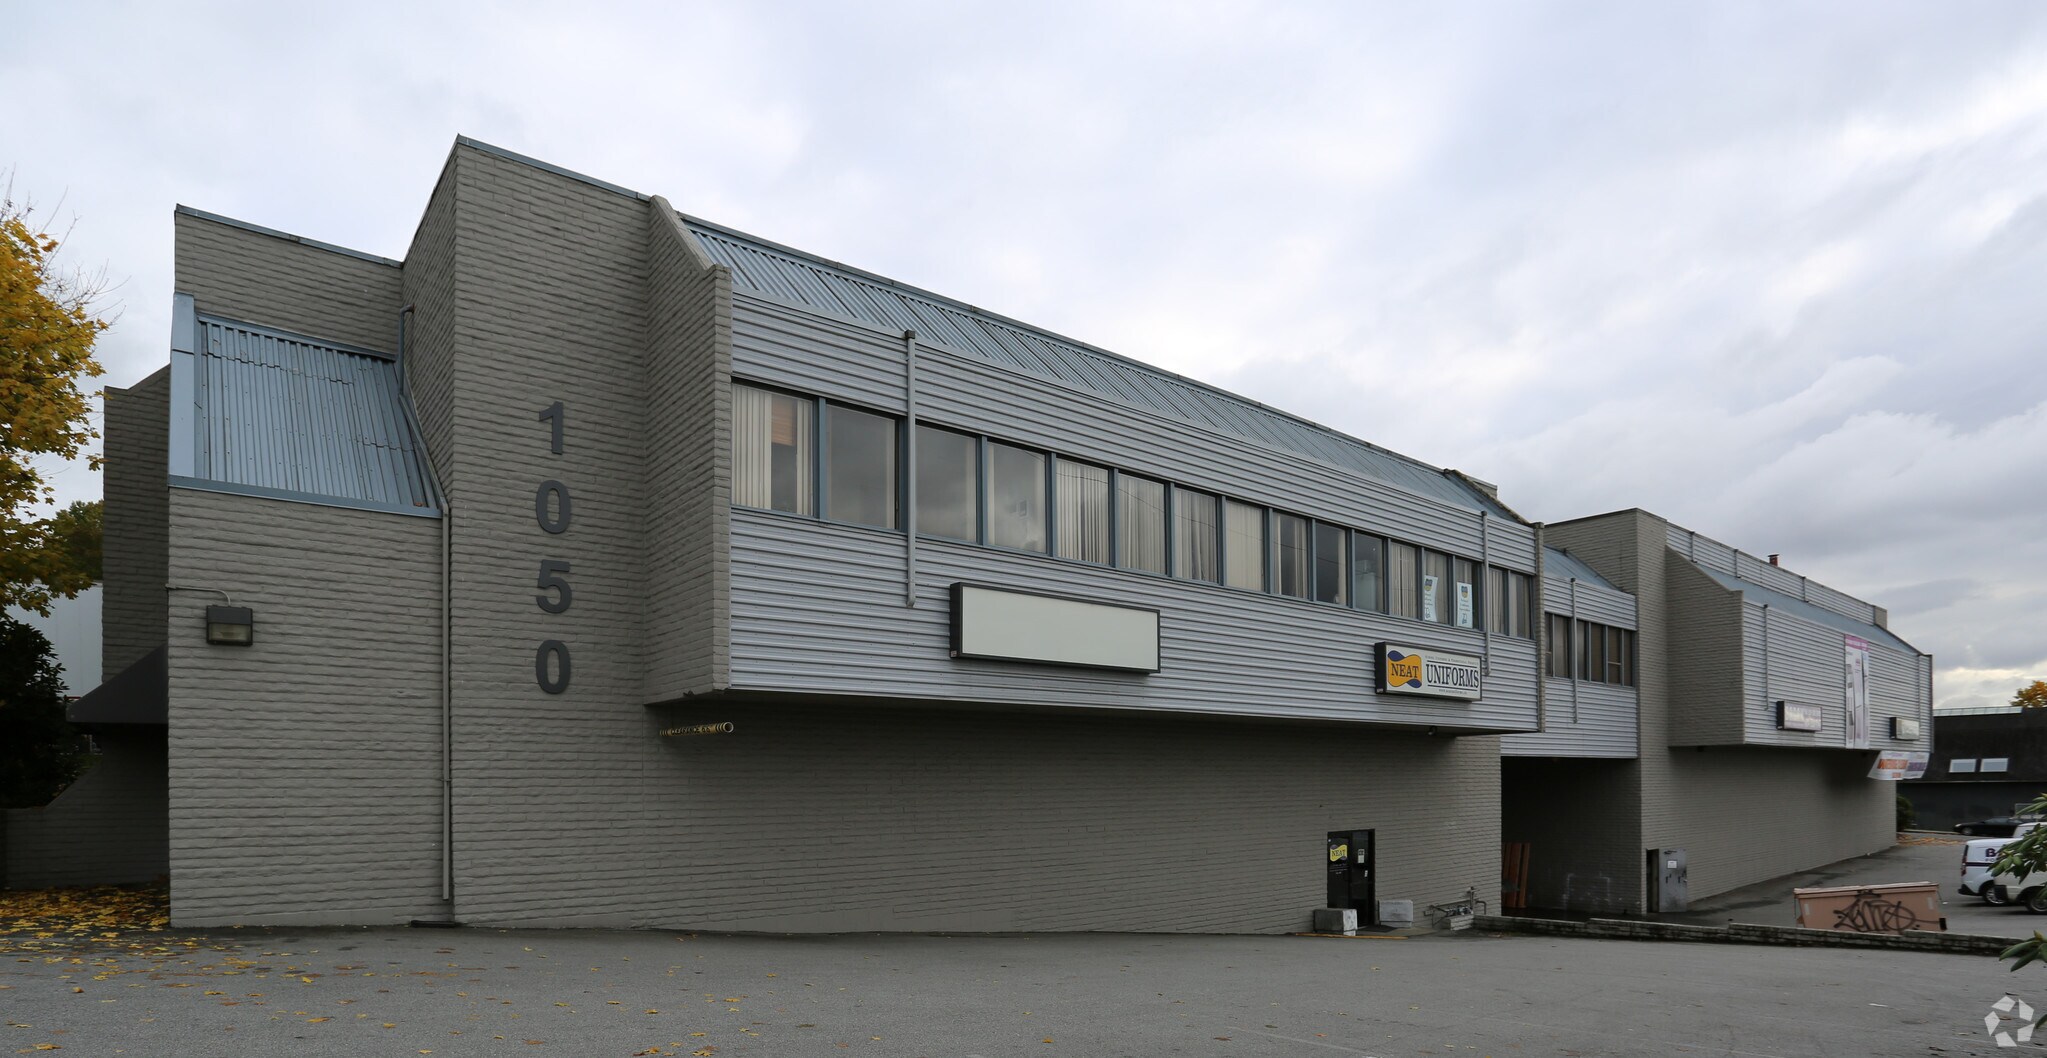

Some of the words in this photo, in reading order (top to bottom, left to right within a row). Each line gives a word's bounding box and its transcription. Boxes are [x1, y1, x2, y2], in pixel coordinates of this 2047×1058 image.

[536, 401, 572, 694] 1050
[1391, 663, 1419, 678] NEAT
[1426, 664, 1479, 688] UNIFORMS
[1331, 849, 1346, 857] NEAT
